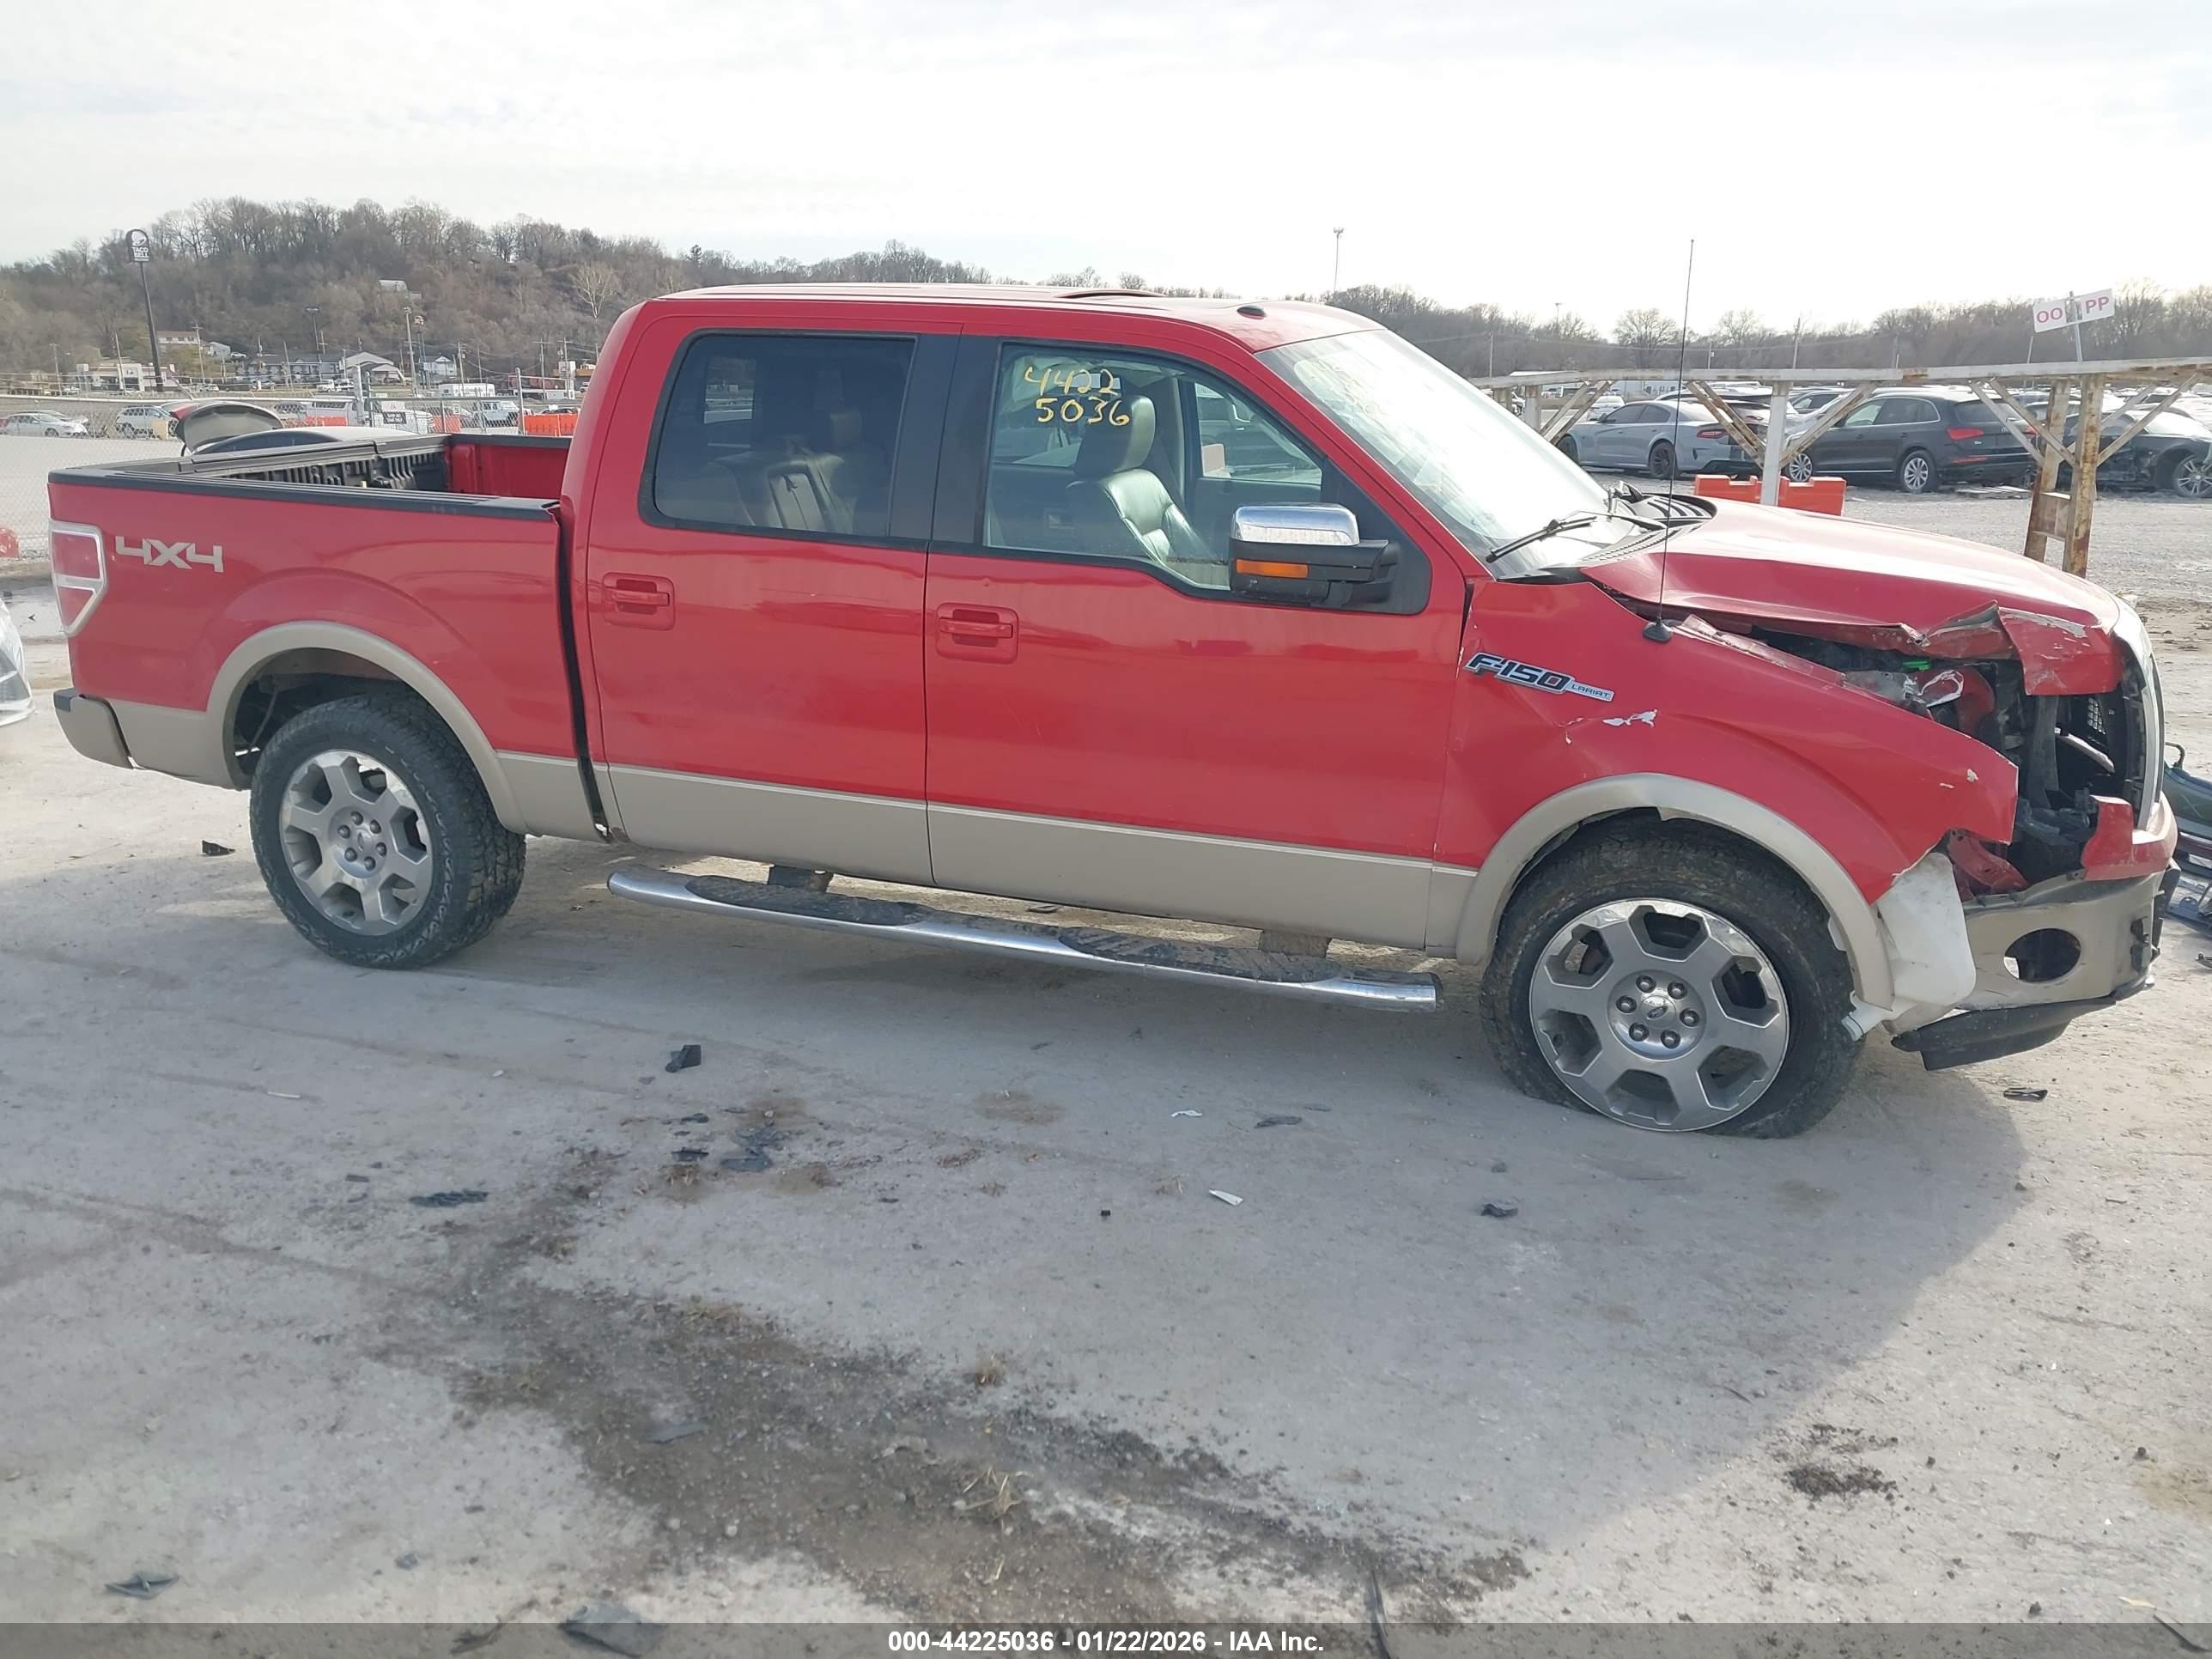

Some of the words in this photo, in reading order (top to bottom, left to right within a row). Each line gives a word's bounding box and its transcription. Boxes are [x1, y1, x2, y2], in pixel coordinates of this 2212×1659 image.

[2037, 307, 2063, 323] OO
[2085, 296, 2110, 313] PP
[1024, 366, 1121, 397] 4422
[1035, 396, 1131, 426] 5036
[115, 536, 224, 573] 4X4
[1466, 653, 1573, 691] F-150
[1571, 684, 1612, 697] LARIAT
